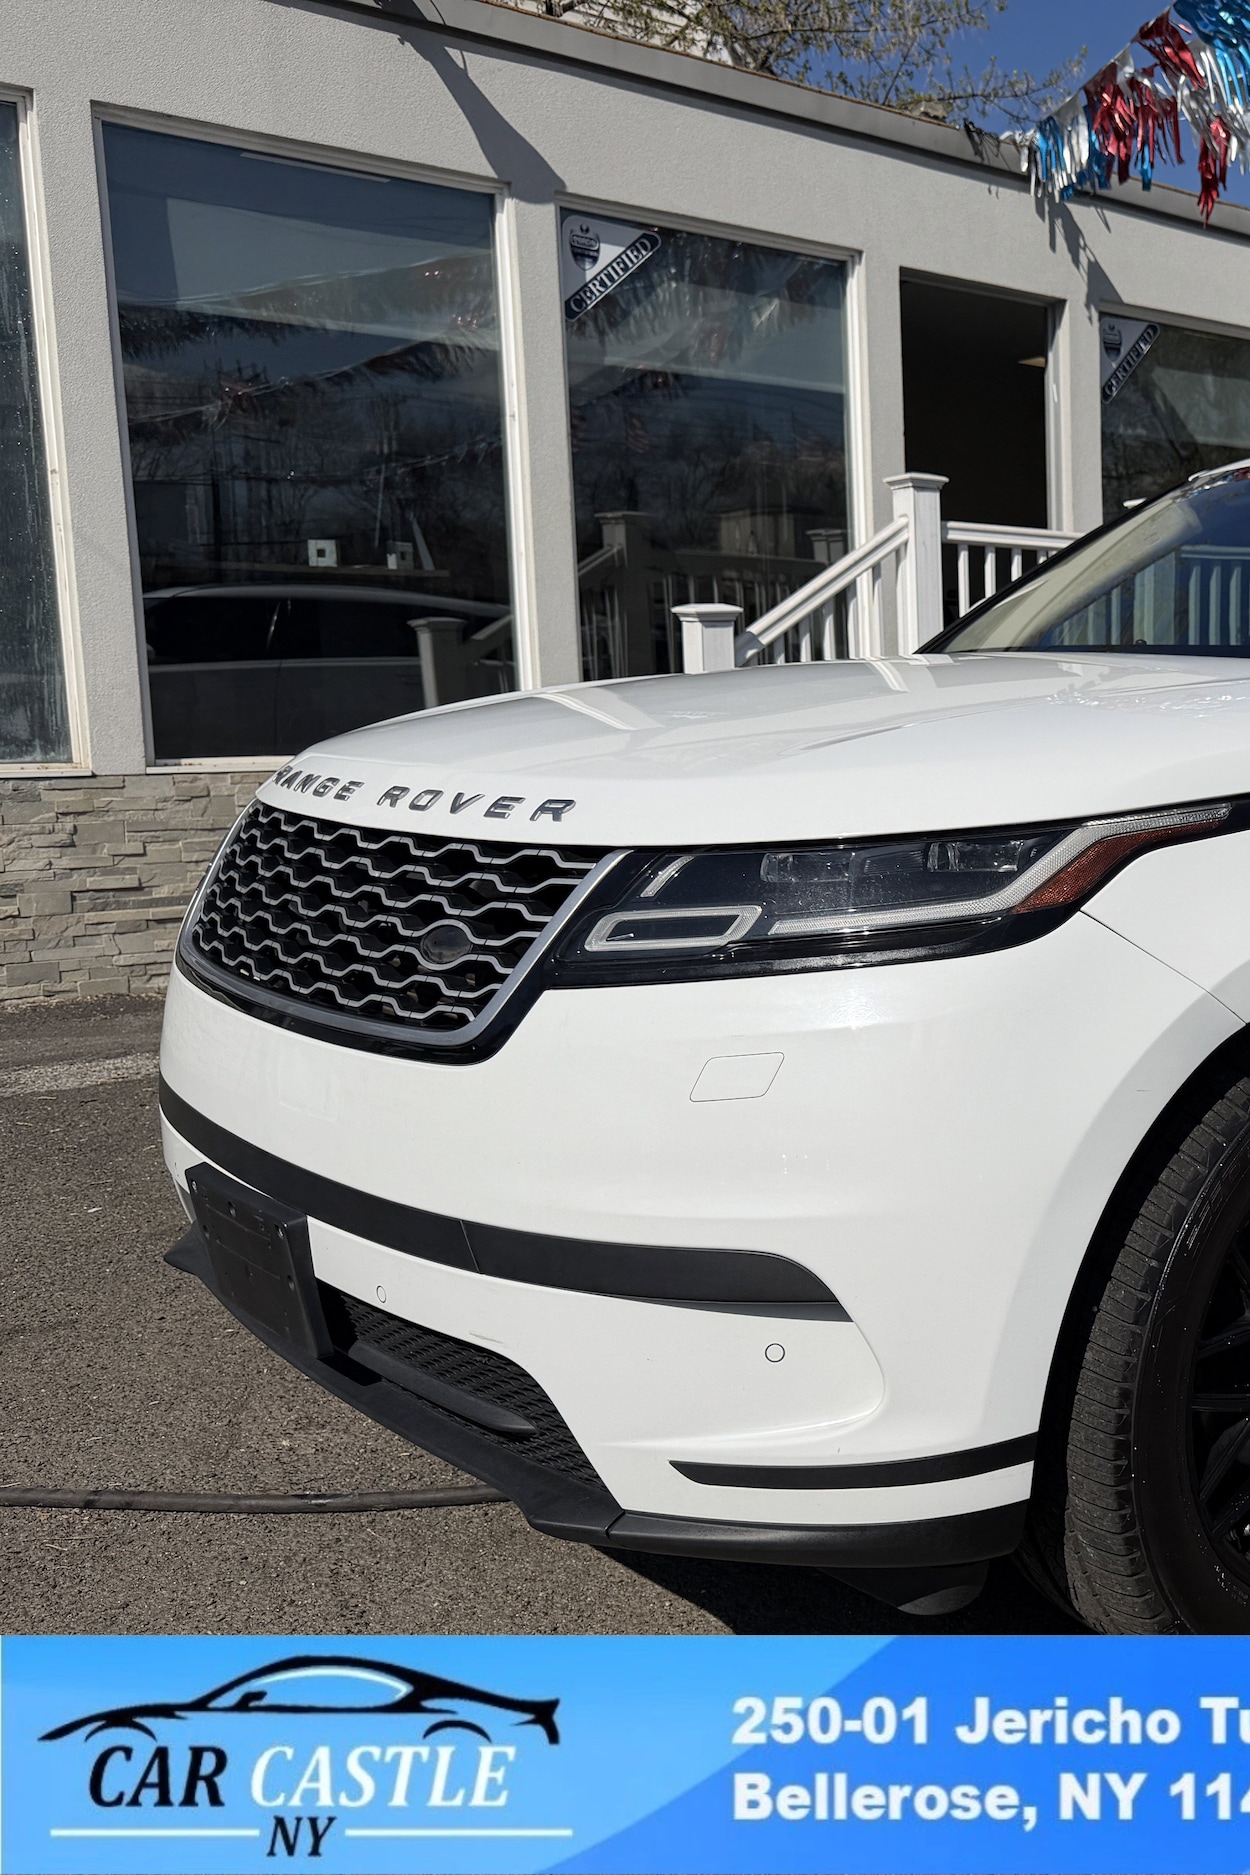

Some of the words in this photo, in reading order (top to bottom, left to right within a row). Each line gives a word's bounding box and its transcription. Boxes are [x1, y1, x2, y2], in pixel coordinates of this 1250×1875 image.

[570, 238, 652, 313] CERTIFIED
[1104, 328, 1155, 395] CERTIFIED
[272, 765, 364, 801] RANGE
[376, 785, 576, 823] ROVER
